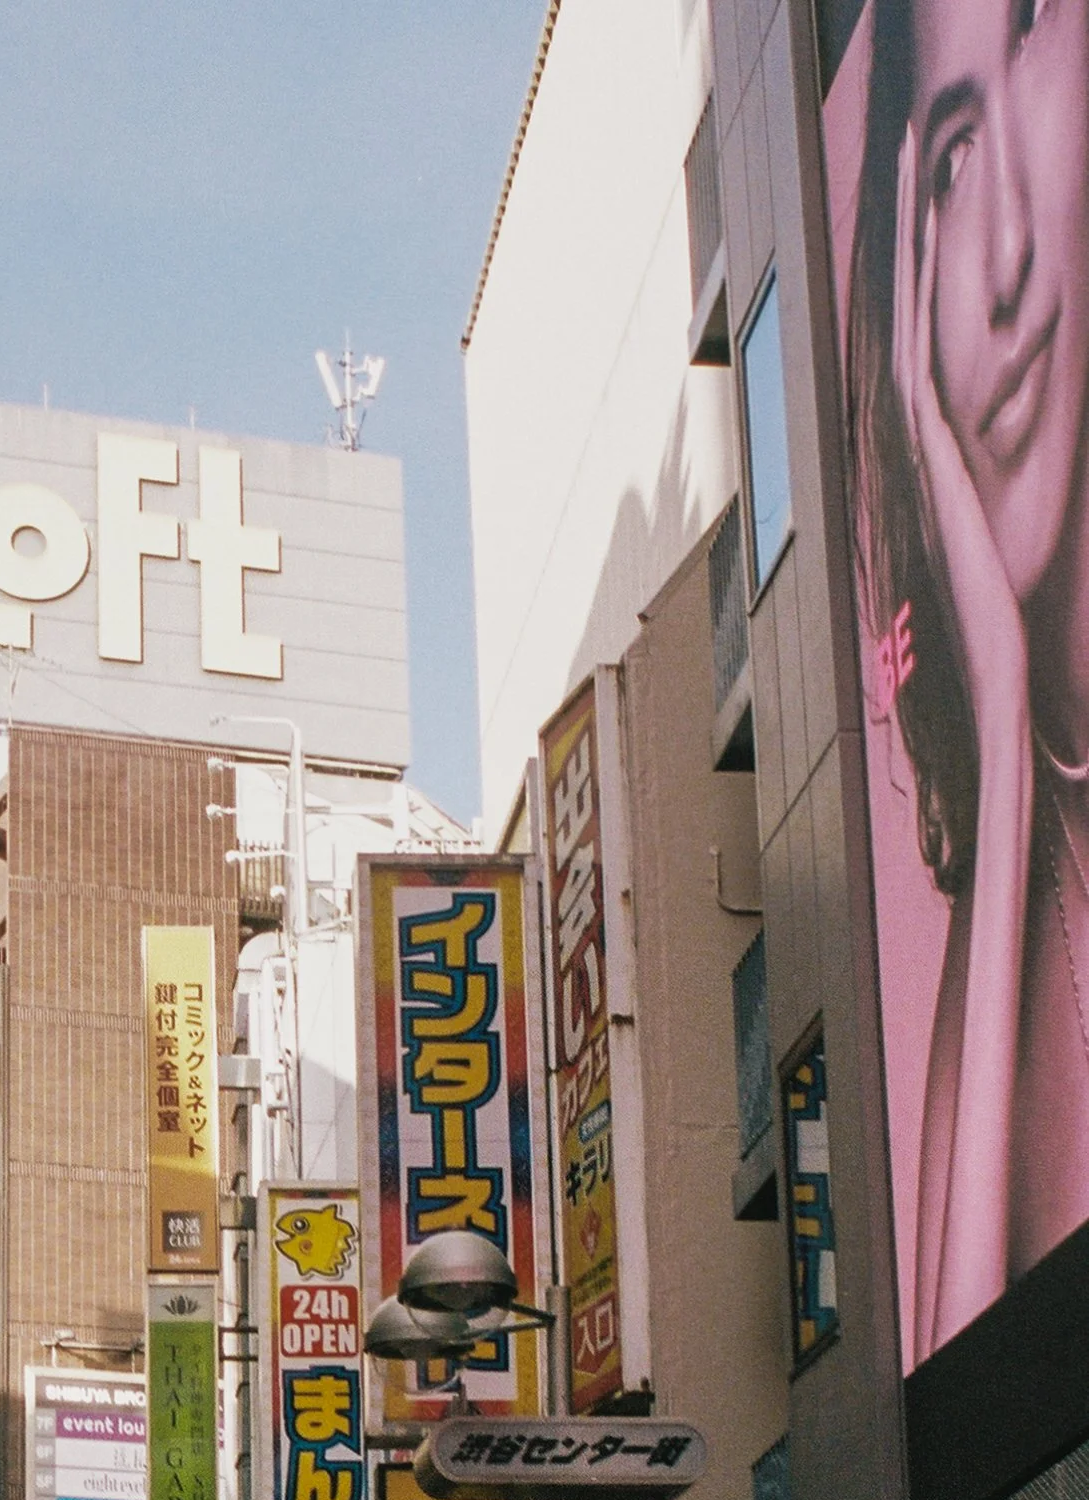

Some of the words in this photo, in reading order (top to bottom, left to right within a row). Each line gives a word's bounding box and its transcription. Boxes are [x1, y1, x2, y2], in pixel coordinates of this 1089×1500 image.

[293, 1289, 349, 1319] 24h
[282, 1323, 356, 1354] OPEN
[63, 1416, 114, 1434] event
